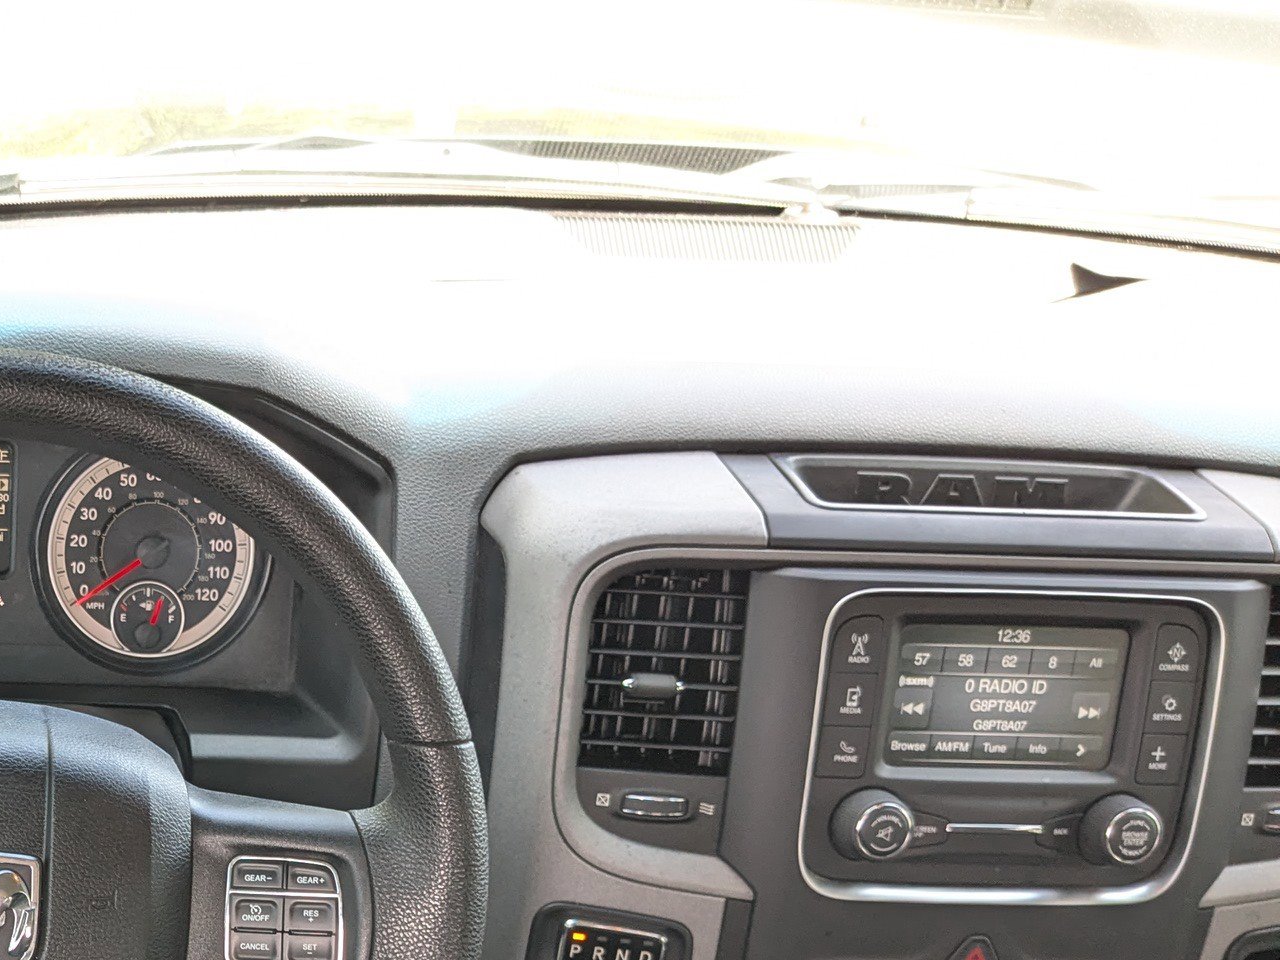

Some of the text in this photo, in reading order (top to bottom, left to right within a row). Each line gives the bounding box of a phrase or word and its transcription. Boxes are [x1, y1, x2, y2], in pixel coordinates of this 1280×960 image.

[120, 474, 137, 487] 50
[94, 488, 112, 500] 40
[856, 470, 1069, 510] RAM
[80, 508, 98, 521] 30
[208, 512, 226, 526] 90
[70, 535, 88, 548] 20
[209, 540, 232, 552] 100
[70, 562, 86, 574] 10
[208, 566, 229, 580] 110
[79, 584, 88, 596] 0
[195, 589, 218, 602] 120
[86, 602, 104, 610] MPH
[120, 614, 126, 622] E
[168, 615, 174, 624] F
[997, 630, 1030, 644] 12:36
[848, 656, 869, 664] RADIO
[914, 652, 930, 666] 57
[958, 654, 974, 666] 58
[1001, 655, 1017, 668] 62
[1048, 656, 1057, 669] 8
[1089, 658, 1103, 668] All
[1159, 664, 1189, 672] COMPASS
[979, 679, 1028, 694] RADIO
[1032, 680, 1047, 694] ID
[840, 706, 862, 714] MEDIA
[970, 699, 1036, 712] G8PT8A07
[1152, 714, 1182, 722] SETTINGS
[973, 720, 1028, 731] G8PT8A07
[890, 740, 927, 752] Browse
[935, 742, 969, 752] AM/FM
[983, 742, 1007, 754] Tune
[1029, 744, 1047, 754] Info
[833, 754, 858, 763] PHONE
[1148, 762, 1168, 770] MORE
[242, 914, 270, 922] ON/OFF
[240, 943, 270, 951] CANCEL
[569, 945, 582, 958] P
[592, 948, 604, 960] R
